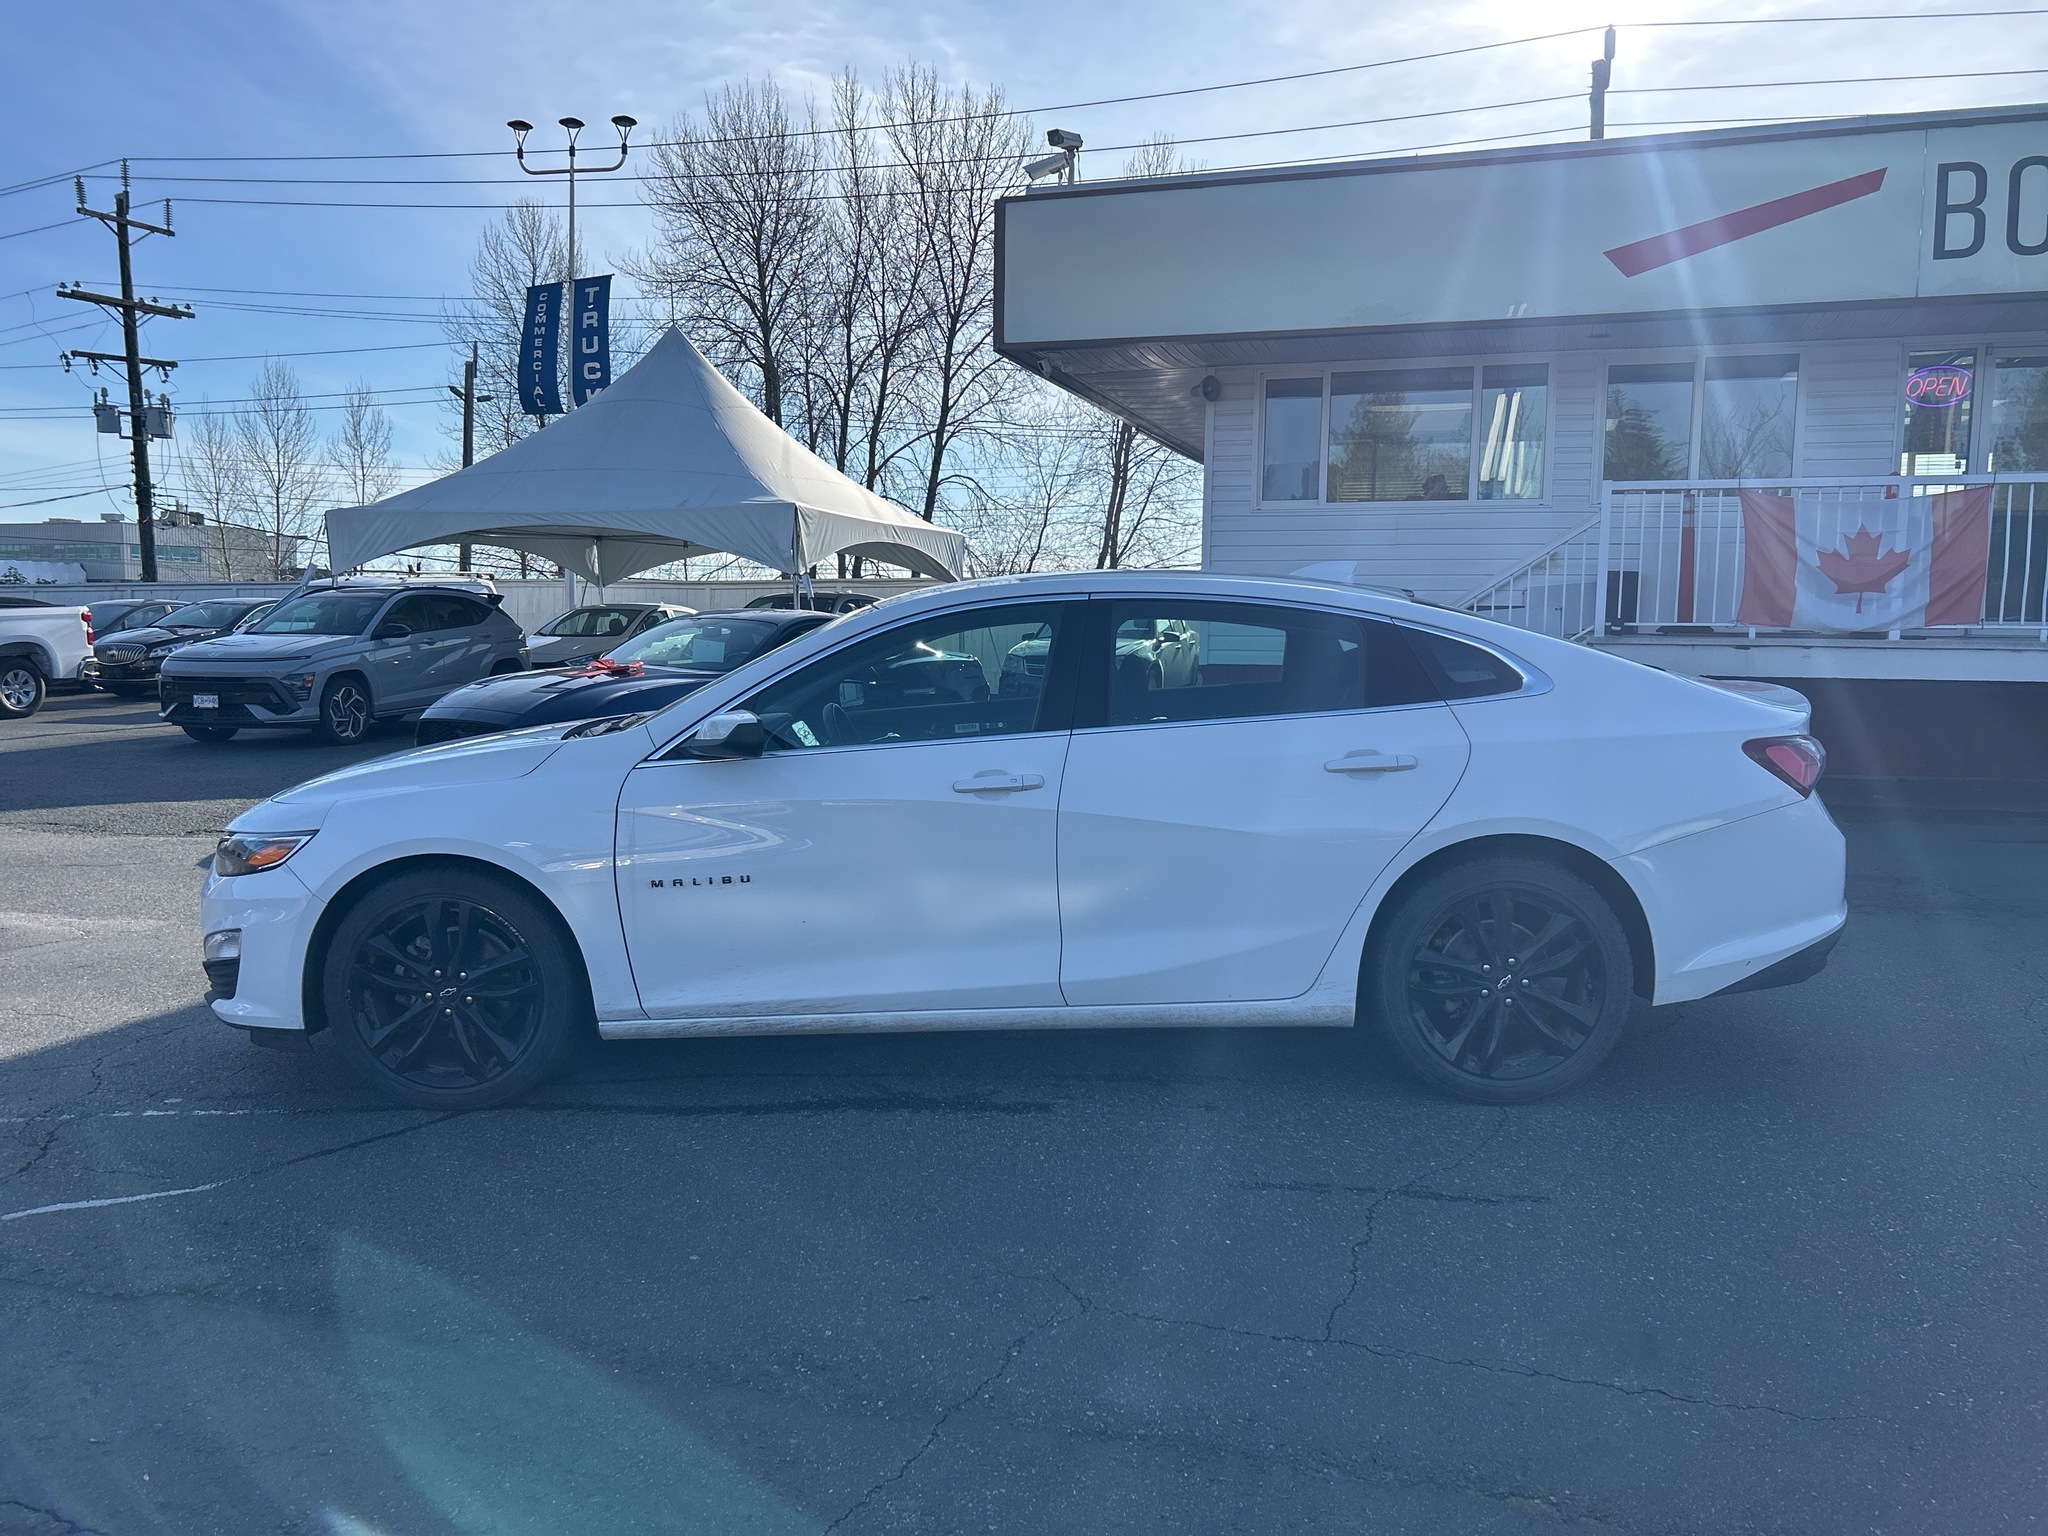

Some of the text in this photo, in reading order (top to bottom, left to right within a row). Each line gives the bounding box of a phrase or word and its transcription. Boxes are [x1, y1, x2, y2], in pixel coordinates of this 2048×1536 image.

[533, 292, 548, 407] COMMERCIAL
[1906, 376, 1969, 397] OPEN
[650, 874, 751, 888] MALIBU
